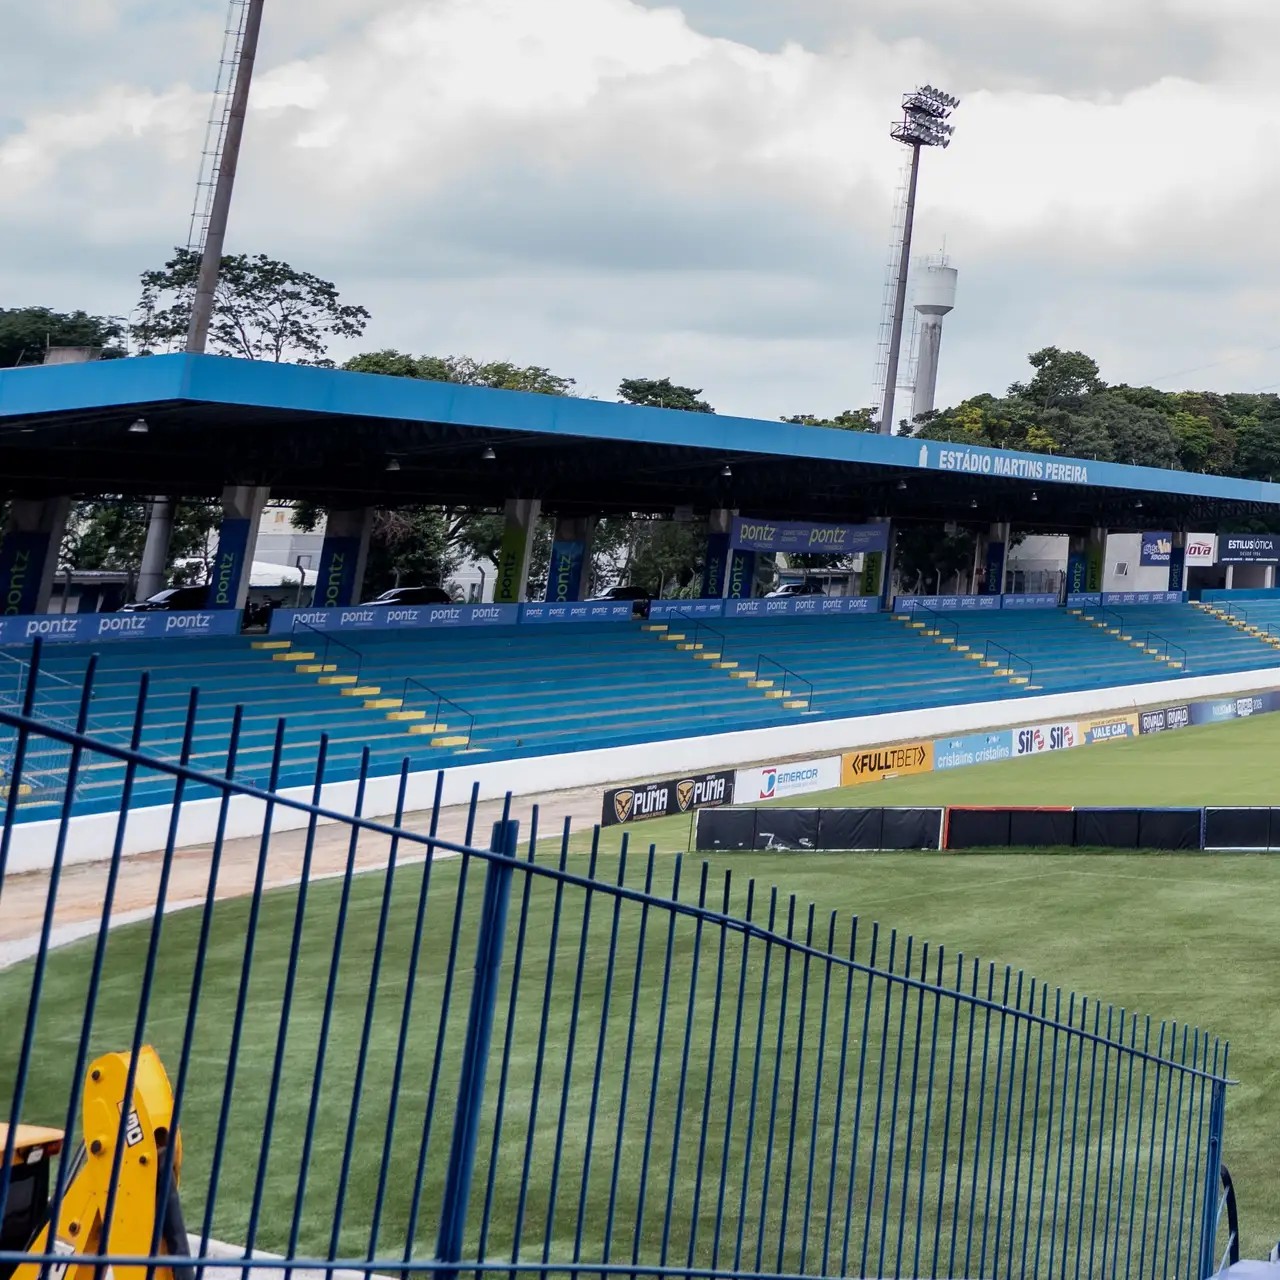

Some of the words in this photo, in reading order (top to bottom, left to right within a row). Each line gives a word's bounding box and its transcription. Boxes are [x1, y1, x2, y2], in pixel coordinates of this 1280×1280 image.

[939, 449, 990, 474] ESTÁDIO
[994, 456, 1042, 478] MARTINS
[1045, 463, 1087, 482] PEREIRA
[740, 524, 776, 543] pontz
[809, 527, 847, 546] pontz
[1228, 539, 1254, 549] ESTILUS
[1255, 539, 1273, 550] ÓTICA
[1185, 543, 1212, 556] ova
[216, 553, 234, 604] pontz
[501, 551, 516, 598] pontz
[292, 611, 327, 625] pontz
[341, 610, 374, 625] pontz
[387, 608, 418, 622] pontz
[430, 608, 460, 621] pontz
[471, 607, 500, 620] pontz
[526, 608, 543, 617] pontz
[549, 607, 566, 617] pontz
[571, 607, 587, 616] pontz
[592, 606, 608, 615] pontz
[612, 606, 628, 614] pontz
[736, 601, 760, 614] pontz
[766, 601, 788, 613] pontz
[795, 600, 816, 612] pontz
[822, 599, 843, 611] pontz
[849, 599, 868, 610] pontz
[26, 618, 77, 638] pontz
[99, 615, 147, 635] pontz
[166, 614, 210, 632] pontz
[1143, 715, 1164, 729] RIVALO
[1168, 709, 1187, 724] RIVALO
[1018, 730, 1033, 753] Sil
[1050, 727, 1063, 749] Sil
[1093, 726, 1110, 738] VALE
[1111, 724, 1126, 735] CAP
[778, 769, 818, 784] EMERCOR
[633, 788, 668, 815] PUMA
[693, 779, 725, 803] PUMA
